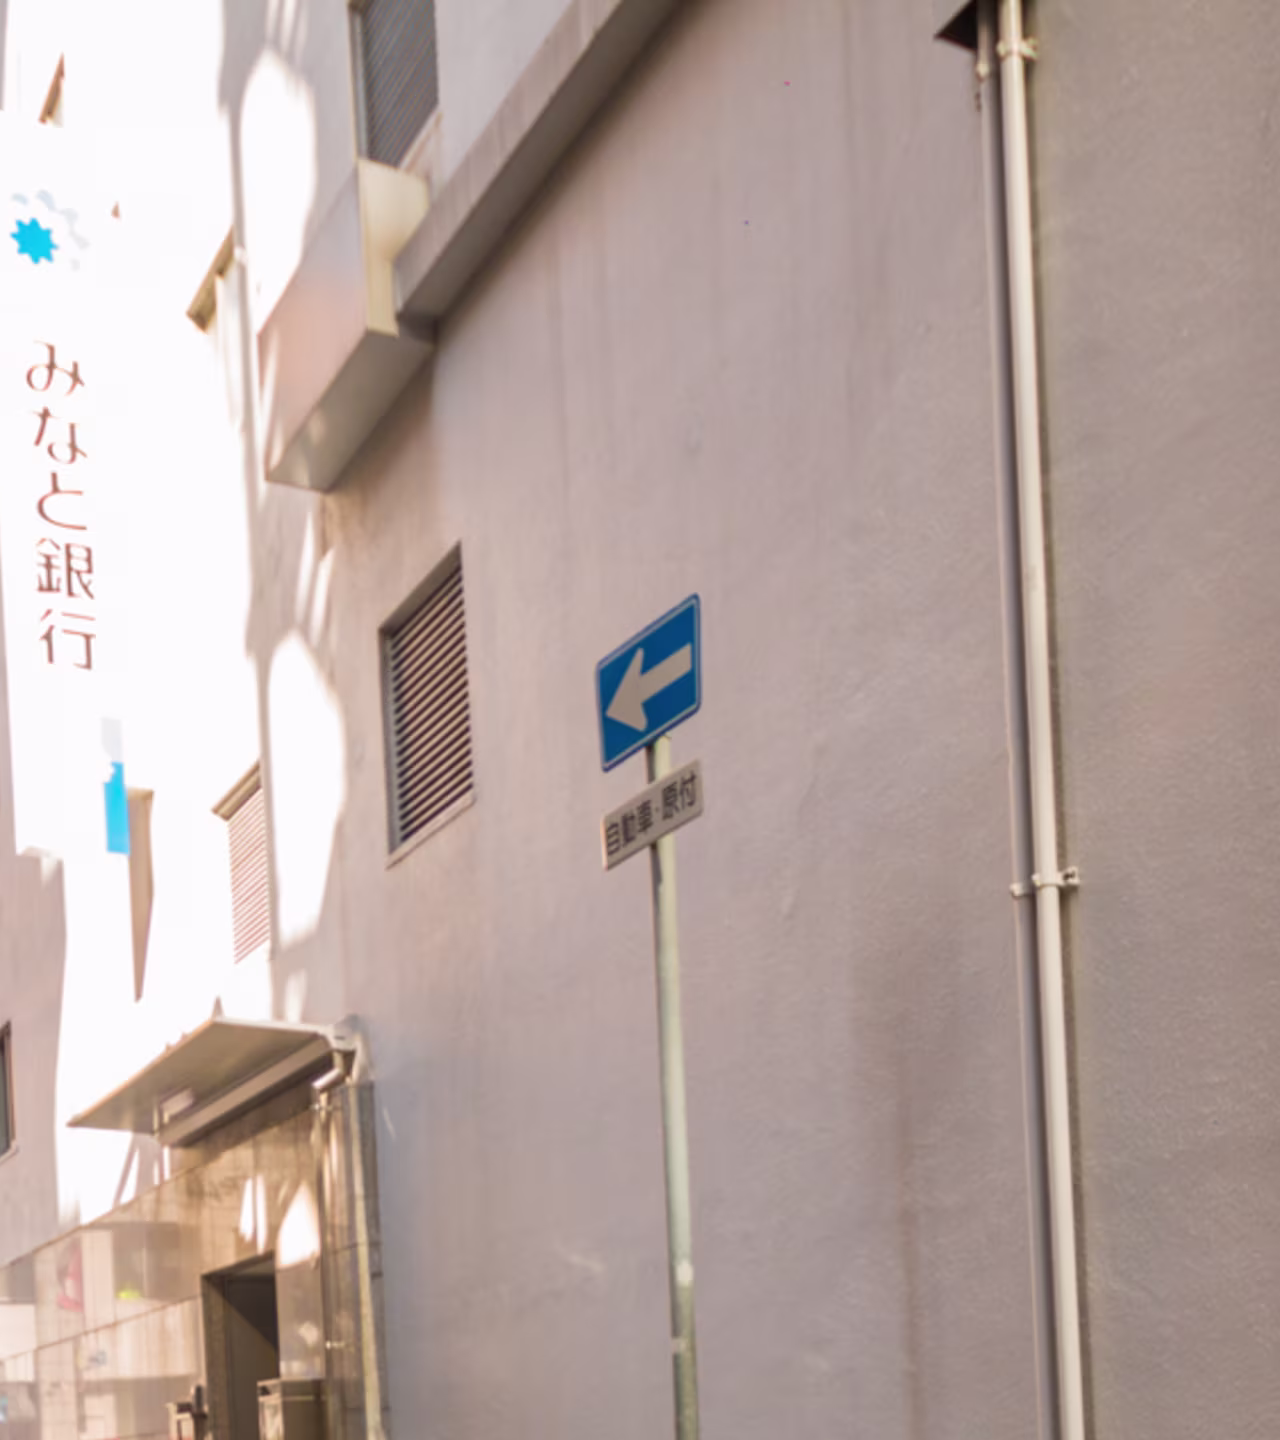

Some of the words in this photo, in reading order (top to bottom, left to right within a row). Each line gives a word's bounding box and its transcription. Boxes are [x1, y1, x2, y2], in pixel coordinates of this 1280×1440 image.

[25, 340, 97, 671] みなと銀行
